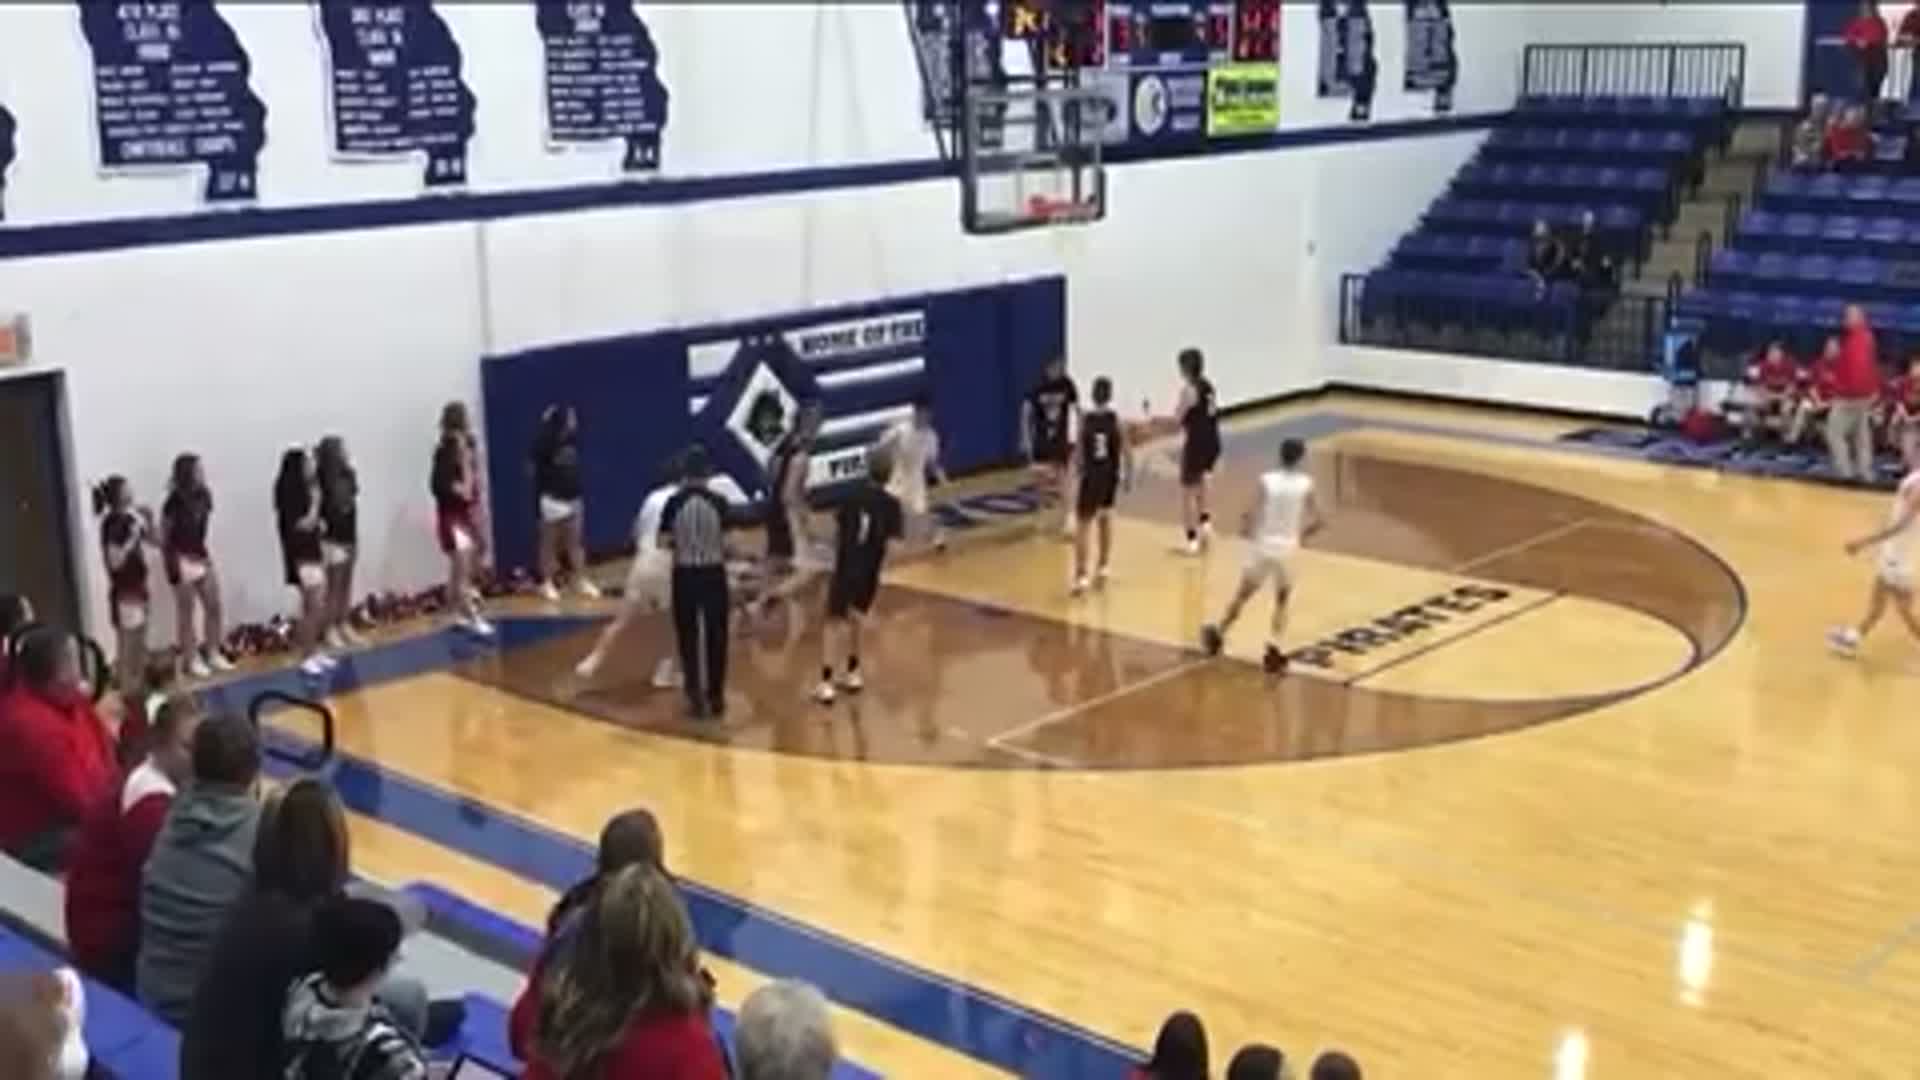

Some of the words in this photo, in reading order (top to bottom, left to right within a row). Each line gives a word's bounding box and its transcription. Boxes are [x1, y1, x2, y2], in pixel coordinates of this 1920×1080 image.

[801, 327, 858, 354] HOME
[862, 323, 885, 343] OF
[1287, 585, 1510, 668] PIRATES
